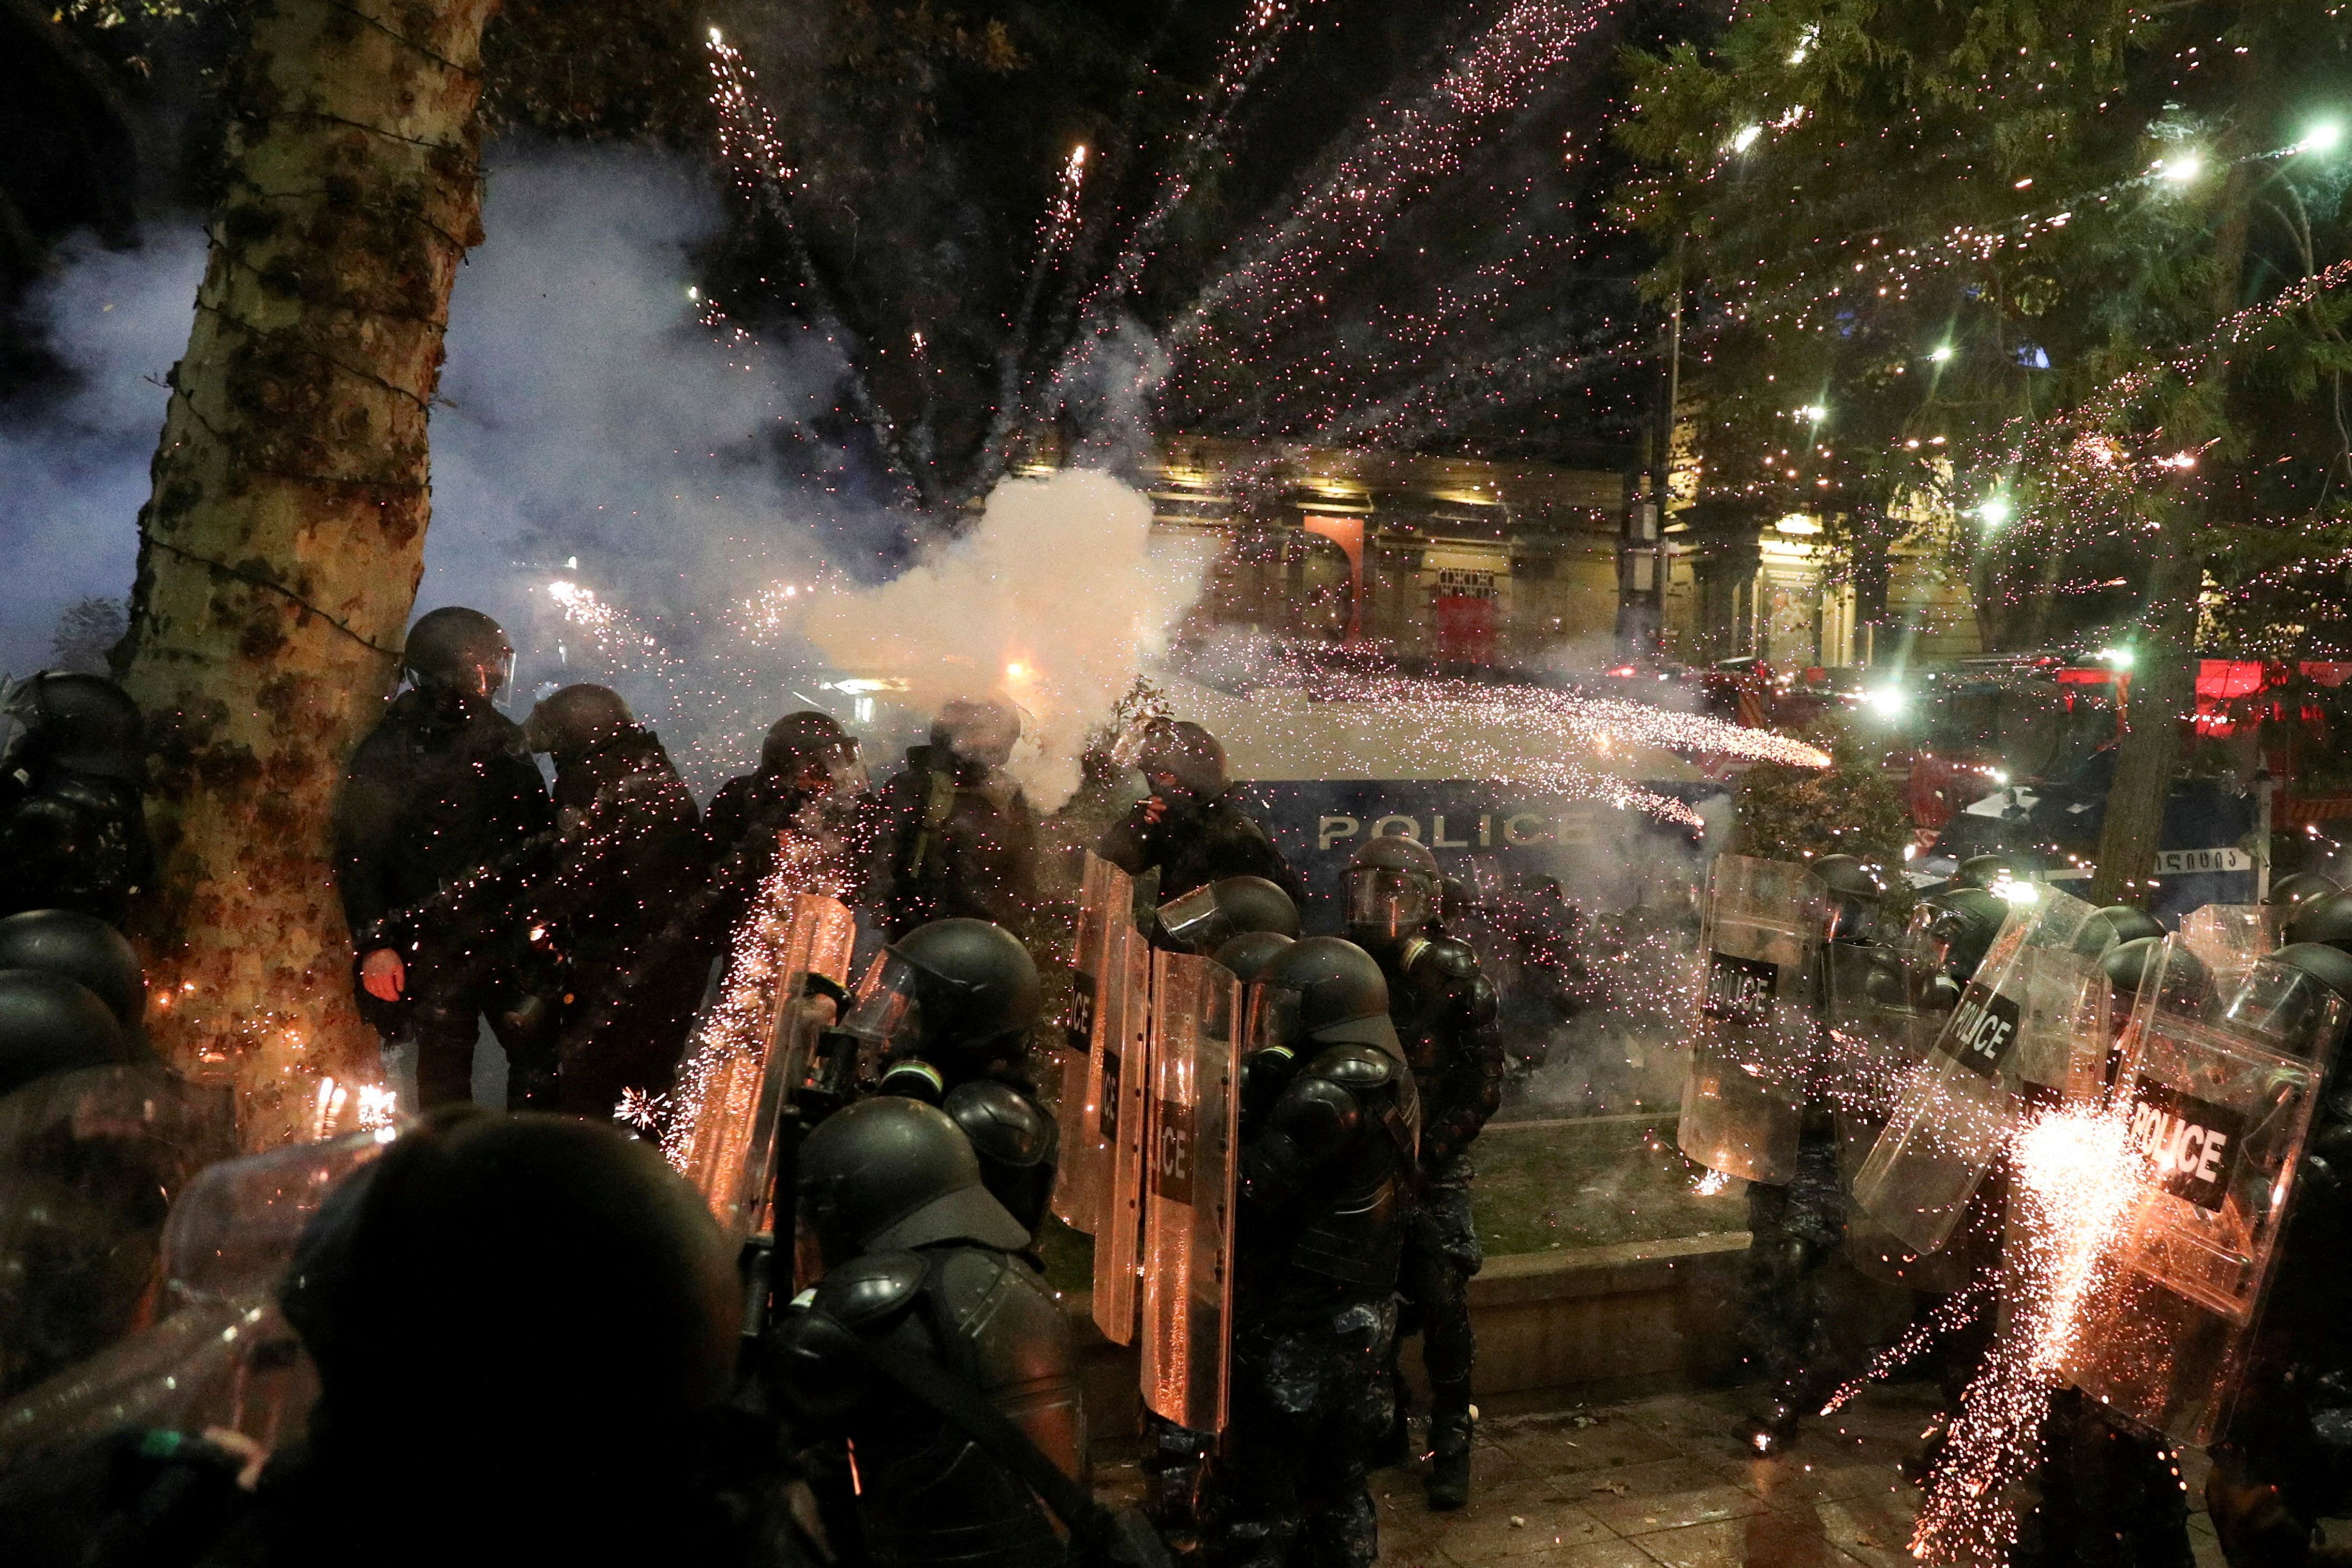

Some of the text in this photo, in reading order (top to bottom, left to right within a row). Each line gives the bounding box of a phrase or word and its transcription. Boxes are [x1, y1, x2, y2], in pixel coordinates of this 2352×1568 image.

[1318, 813, 1595, 850] POLICE
[2156, 850, 2236, 871] ლიცია
[1070, 990, 1091, 1034] ICE
[1711, 968, 1768, 1012] POLICE
[1950, 1000, 2012, 1060] POLICE
[1101, 1072, 1116, 1120] ICE
[1152, 1126, 1186, 1178] ICE
[2129, 1101, 2227, 1183] POLICE
